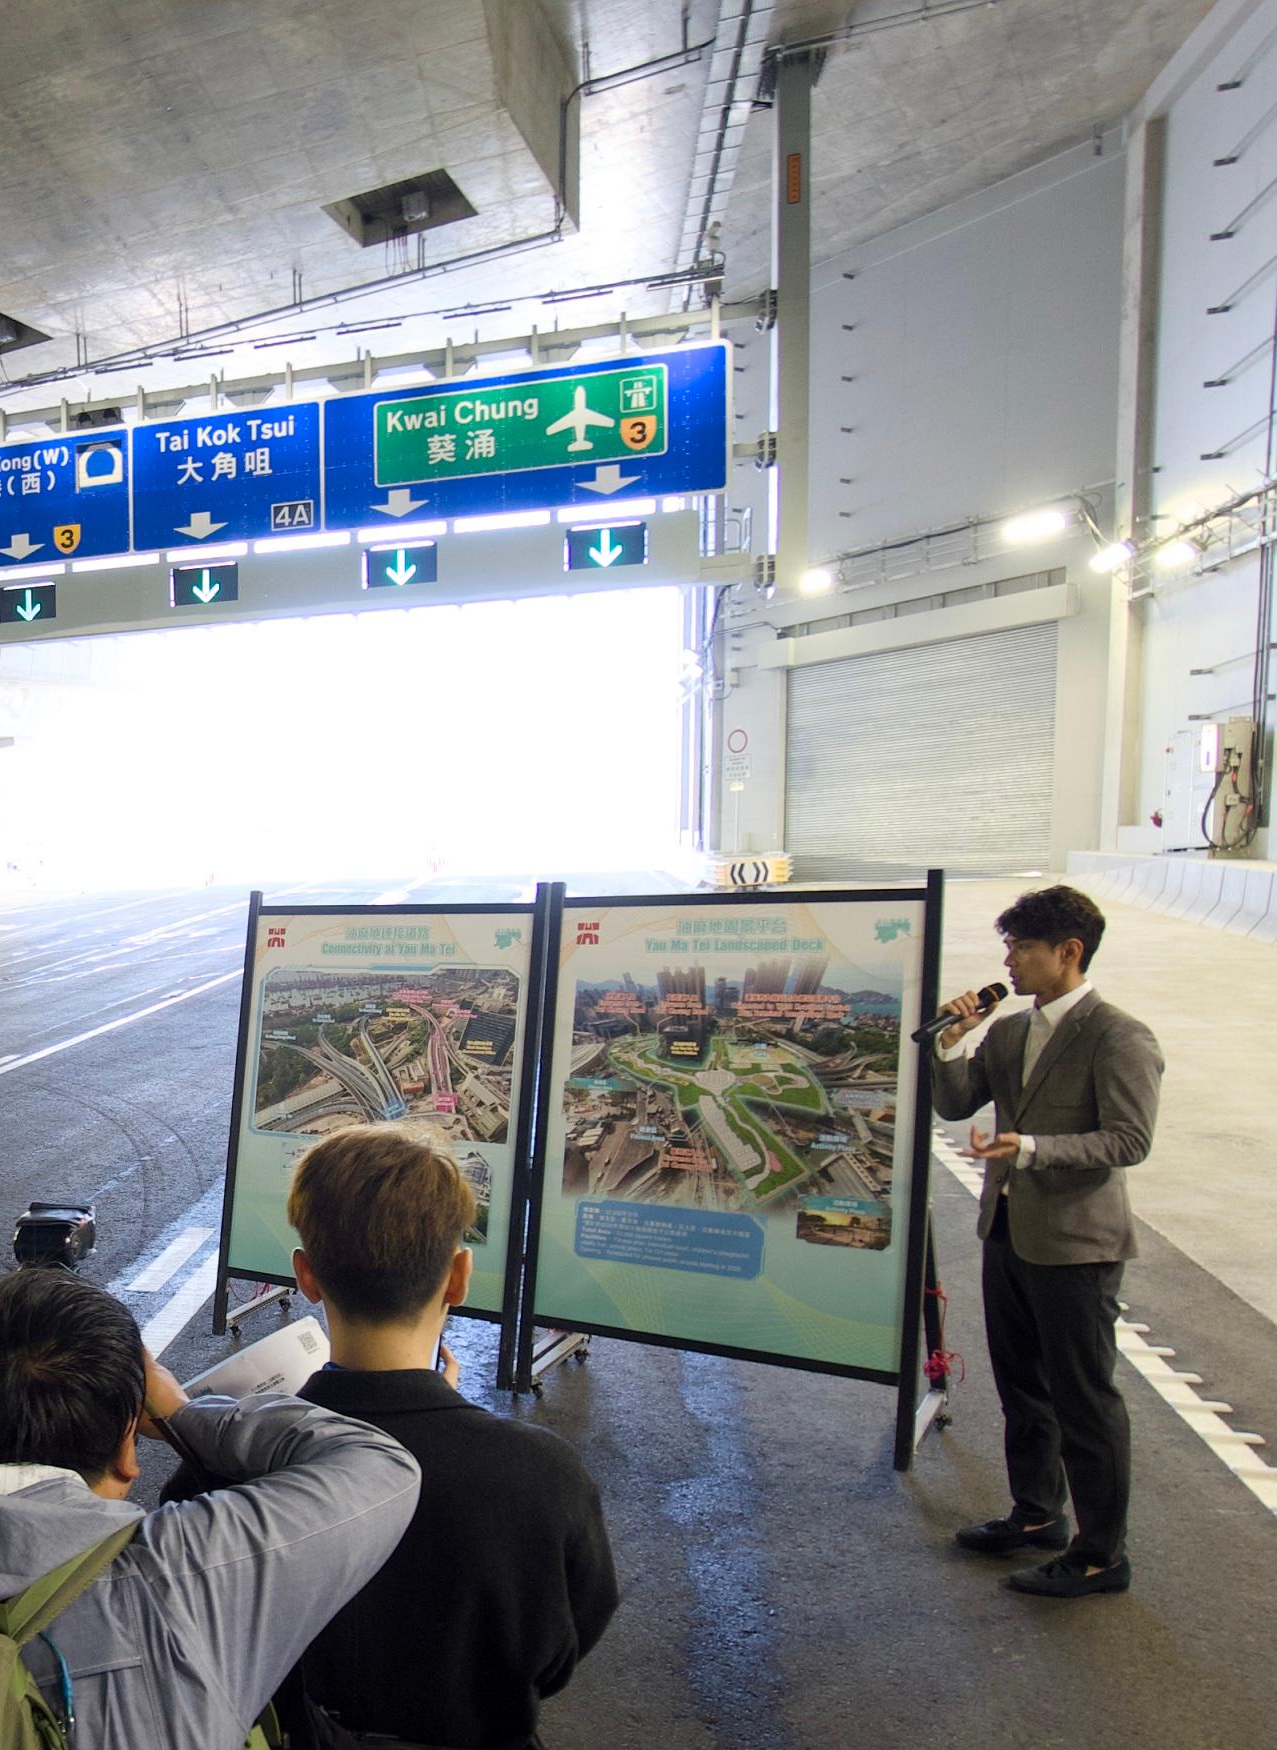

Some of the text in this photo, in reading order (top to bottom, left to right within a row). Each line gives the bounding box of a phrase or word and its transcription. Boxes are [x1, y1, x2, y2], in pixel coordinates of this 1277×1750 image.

[386, 397, 539, 433] Kwai Chung
[155, 415, 295, 453] Tai Kok Tsui
[629, 422, 647, 445] 3
[426, 429, 497, 465] 葵涌
[176, 447, 273, 485] 大角咀
[274, 504, 310, 527] 4A
[59, 528, 74, 550] 3
[322, 943, 381, 955] Connectivity
[420, 944, 436, 955] Ma
[645, 937, 825, 952] Yau Ma Tei Landscaped Deck
